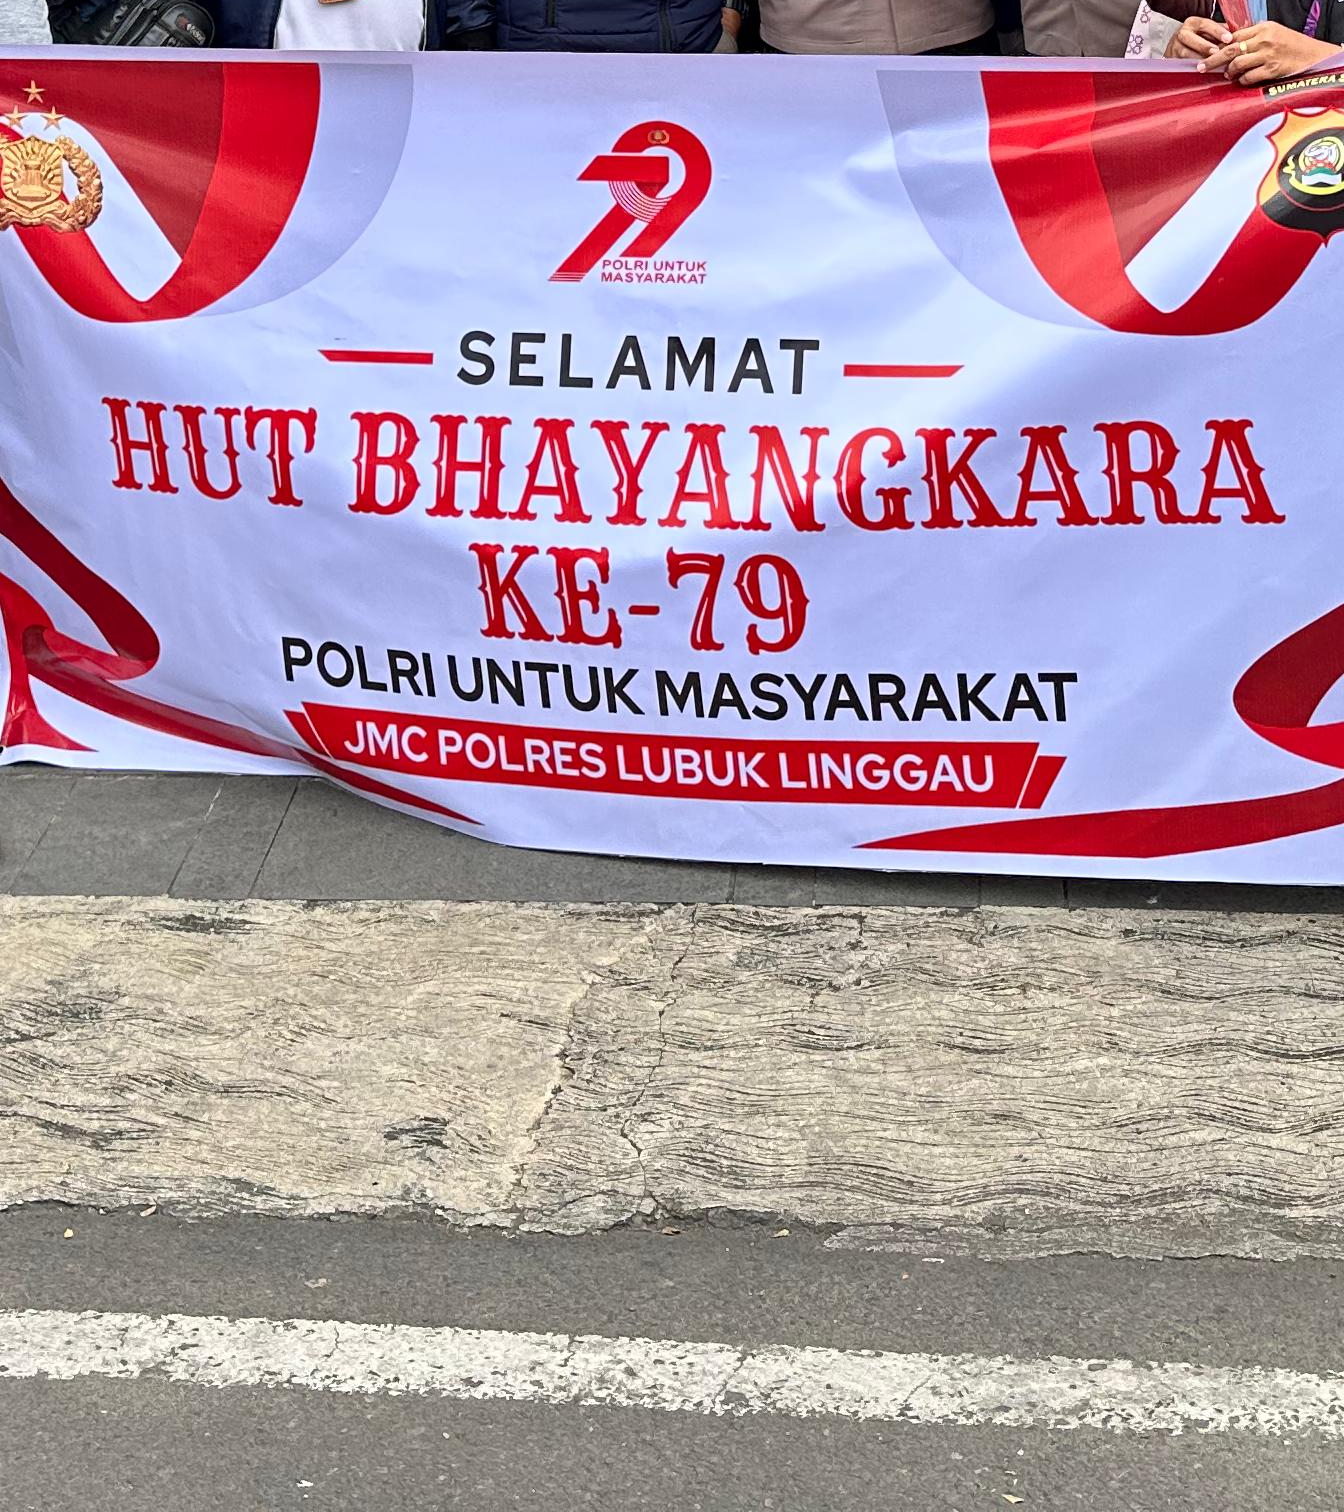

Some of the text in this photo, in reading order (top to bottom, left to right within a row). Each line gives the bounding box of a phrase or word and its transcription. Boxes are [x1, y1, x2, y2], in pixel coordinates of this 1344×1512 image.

[601, 271, 708, 285] MASYARAKAT
[602, 259, 708, 272] POLRI UNTUK
[457, 330, 820, 395] SELAMAT
[101, 396, 1287, 532] HUT BHAYANGKARA
[468, 542, 810, 656] KE-79
[282, 636, 1078, 722] POLRI UNTUK MASYARAKAT
[343, 719, 995, 793] JMC POLRES LUBUK LINGGAU
